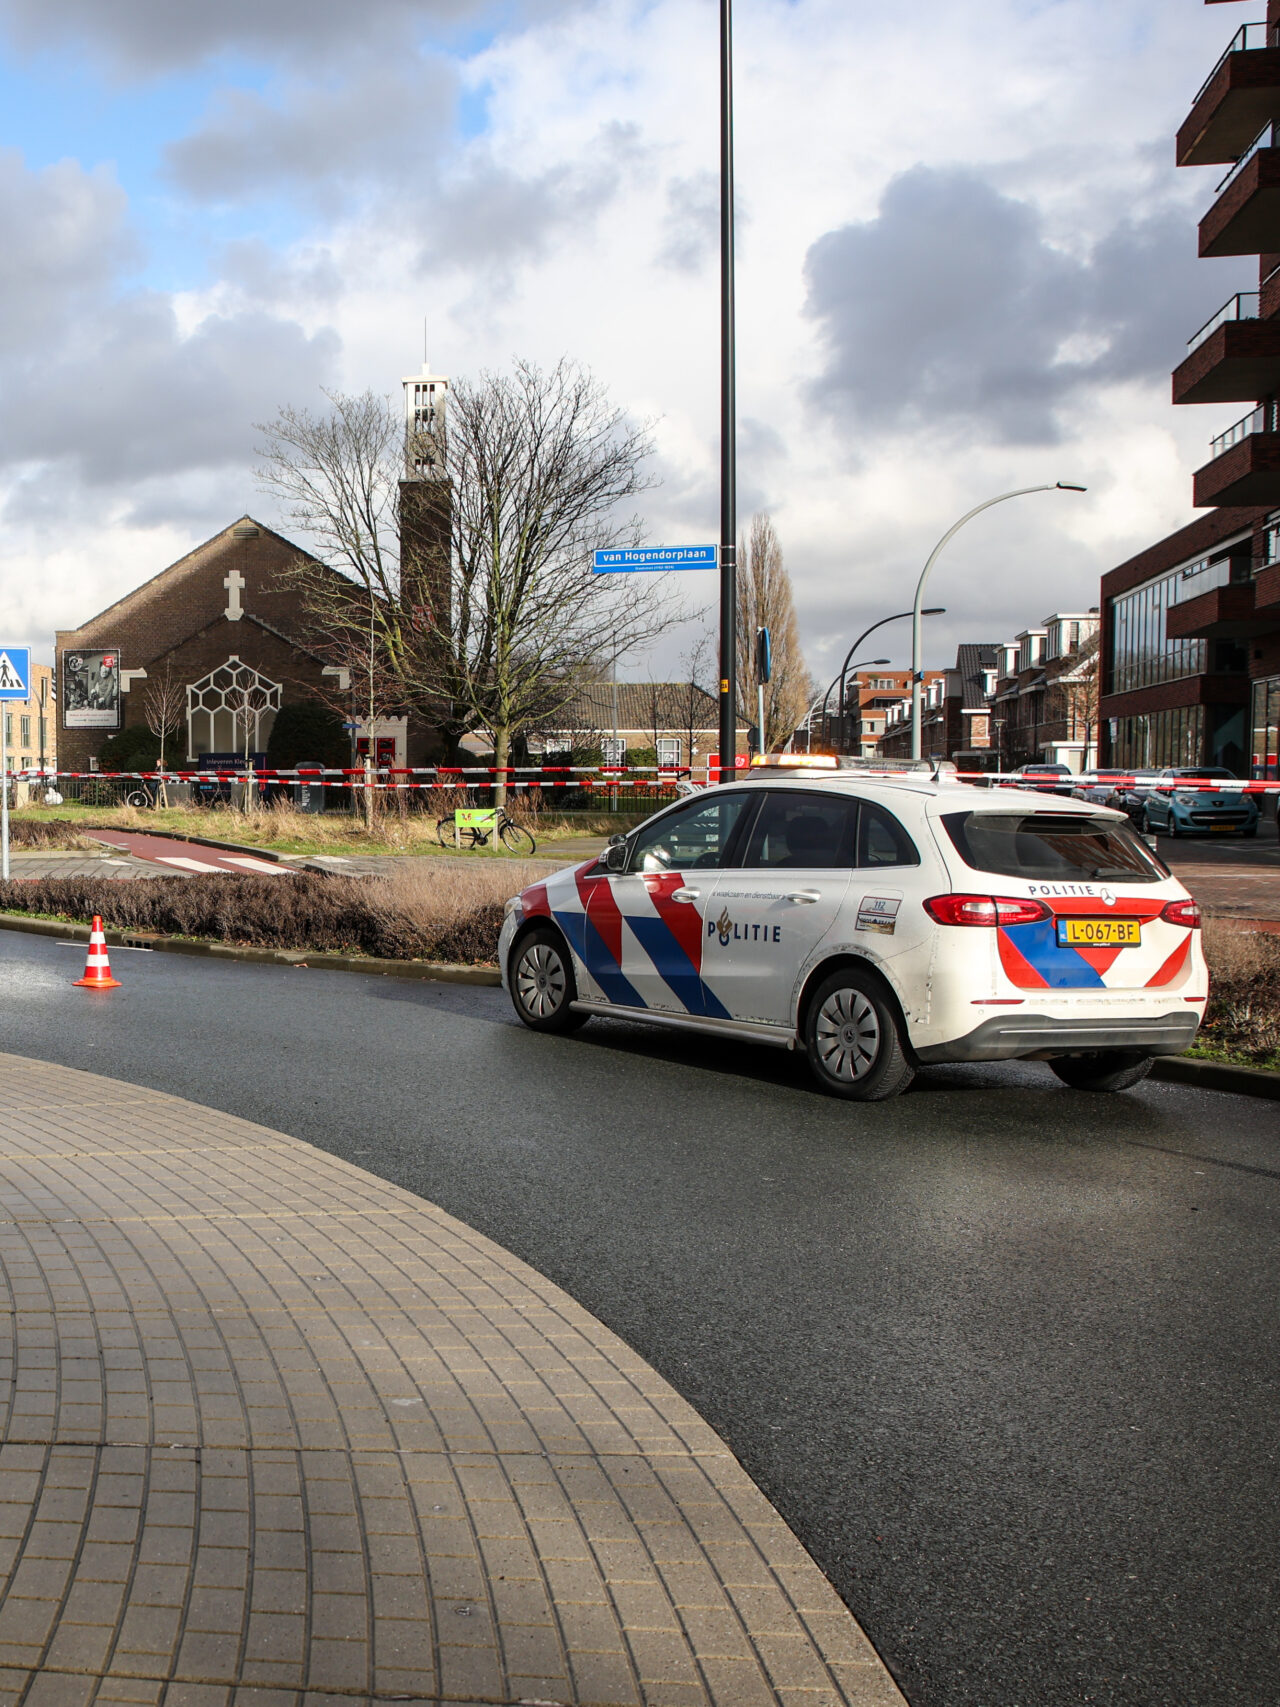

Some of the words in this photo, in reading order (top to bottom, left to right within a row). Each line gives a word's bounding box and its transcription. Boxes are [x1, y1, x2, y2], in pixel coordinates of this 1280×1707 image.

[603, 553, 622, 562] van
[625, 550, 707, 562] Hogendorplaan
[1028, 885, 1095, 895] POLITIE
[874, 900, 886, 908] 112
[708, 921, 781, 946] POLITIE
[1072, 923, 1134, 940] L-067-BF
